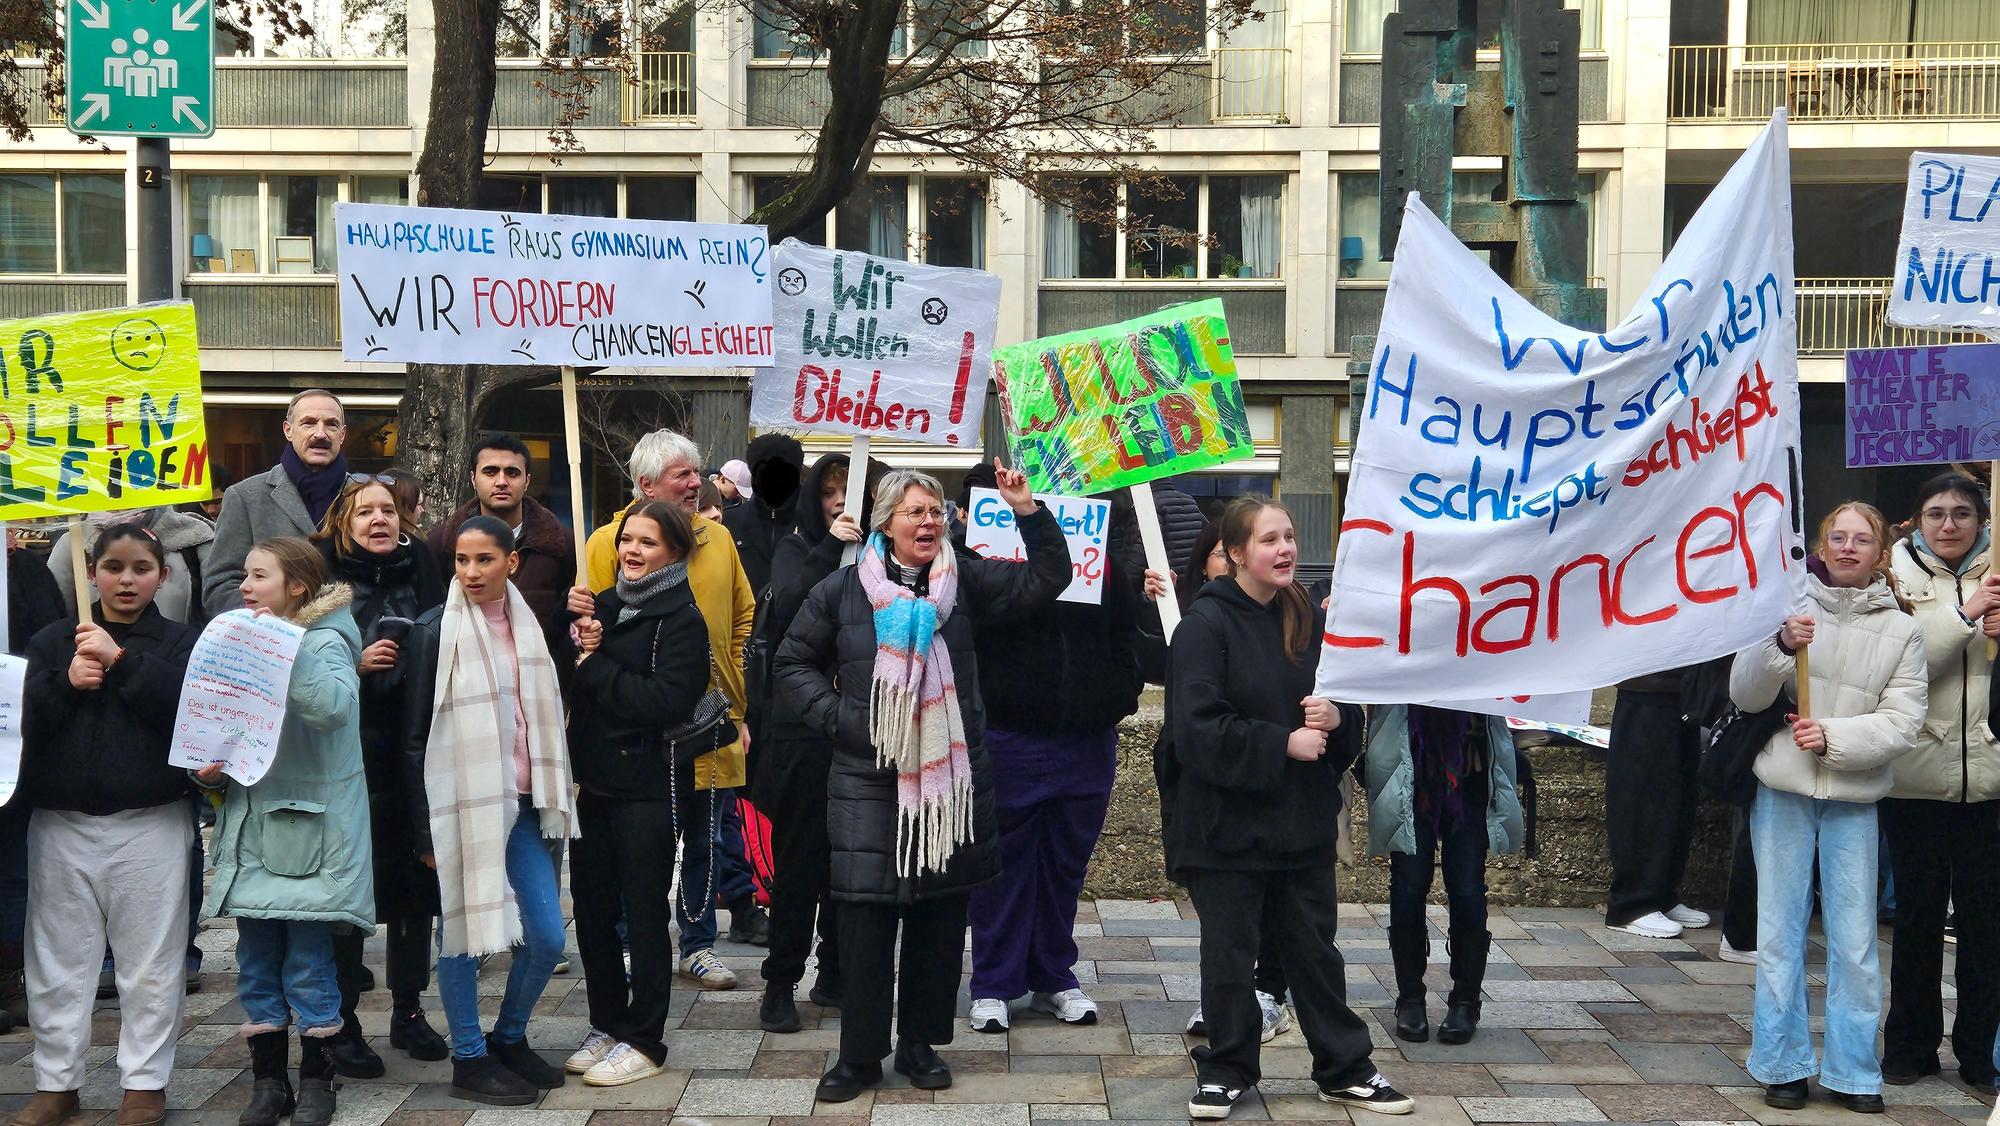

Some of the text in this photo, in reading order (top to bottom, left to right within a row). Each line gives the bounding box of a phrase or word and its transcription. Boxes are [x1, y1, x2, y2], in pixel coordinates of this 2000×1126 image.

[144, 169, 153, 183] 2
[508, 226, 562, 260] RAUS
[571, 230, 688, 260] GYMNASIUM
[699, 236, 766, 283] REIN?
[351, 273, 615, 335] WIR FORDERN
[833, 254, 904, 311] Wir
[572, 322, 773, 361] CHANCENGLEICHEIT
[802, 308, 909, 360] Wollen
[1849, 347, 1947, 379] WAT E
[1850, 373, 1971, 406] THEATER
[1848, 402, 1937, 432] WAT E
[973, 497, 1107, 545] Geert!
